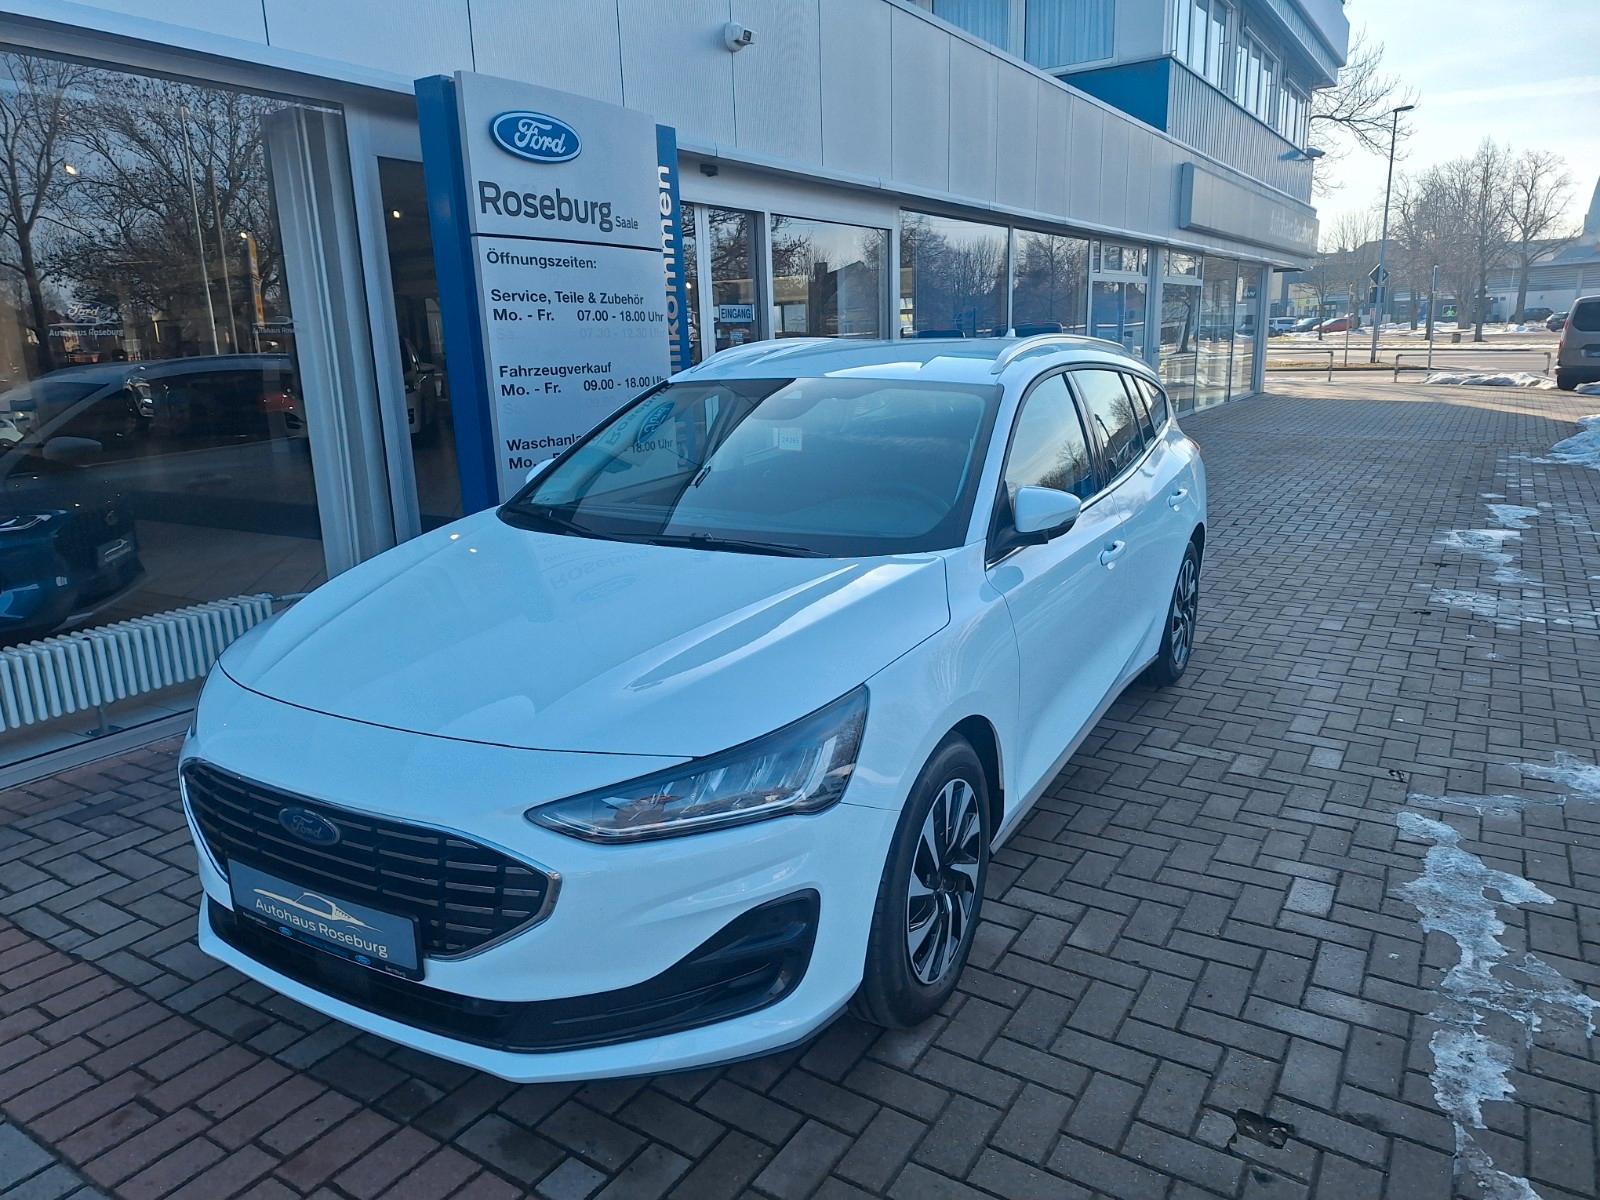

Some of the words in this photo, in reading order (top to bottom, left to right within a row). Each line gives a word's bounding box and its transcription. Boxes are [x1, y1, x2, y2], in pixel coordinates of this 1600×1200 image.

[514, 118, 566, 154] Ford
[478, 180, 614, 233] Roseburg
[615, 215, 639, 230] Saale
[486, 247, 597, 270] Öffnungszeiten:
[491, 288, 551, 304] Service,
[554, 290, 585, 304] Teile
[588, 292, 597, 304] &
[600, 292, 644, 305] Zubehör
[493, 308, 523, 321] Mo.
[537, 309, 555, 321] Fr.
[577, 309, 609, 322] 07.00
[620, 311, 646, 322] 18.00
[648, 311, 665, 323] Uhr
[721, 308, 751, 319] EINGANG
[499, 361, 612, 378] Fahrzeugverkauf
[501, 383, 530, 397] Mo.
[545, 382, 562, 394] Fr.
[583, 379, 614, 392] 09.00
[625, 376, 650, 388] 18.00
[632, 440, 656, 453] 18.00
[293, 815, 323, 839] Ford
[255, 898, 316, 932] Autohaus
[318, 922, 388, 959] Roseburg
